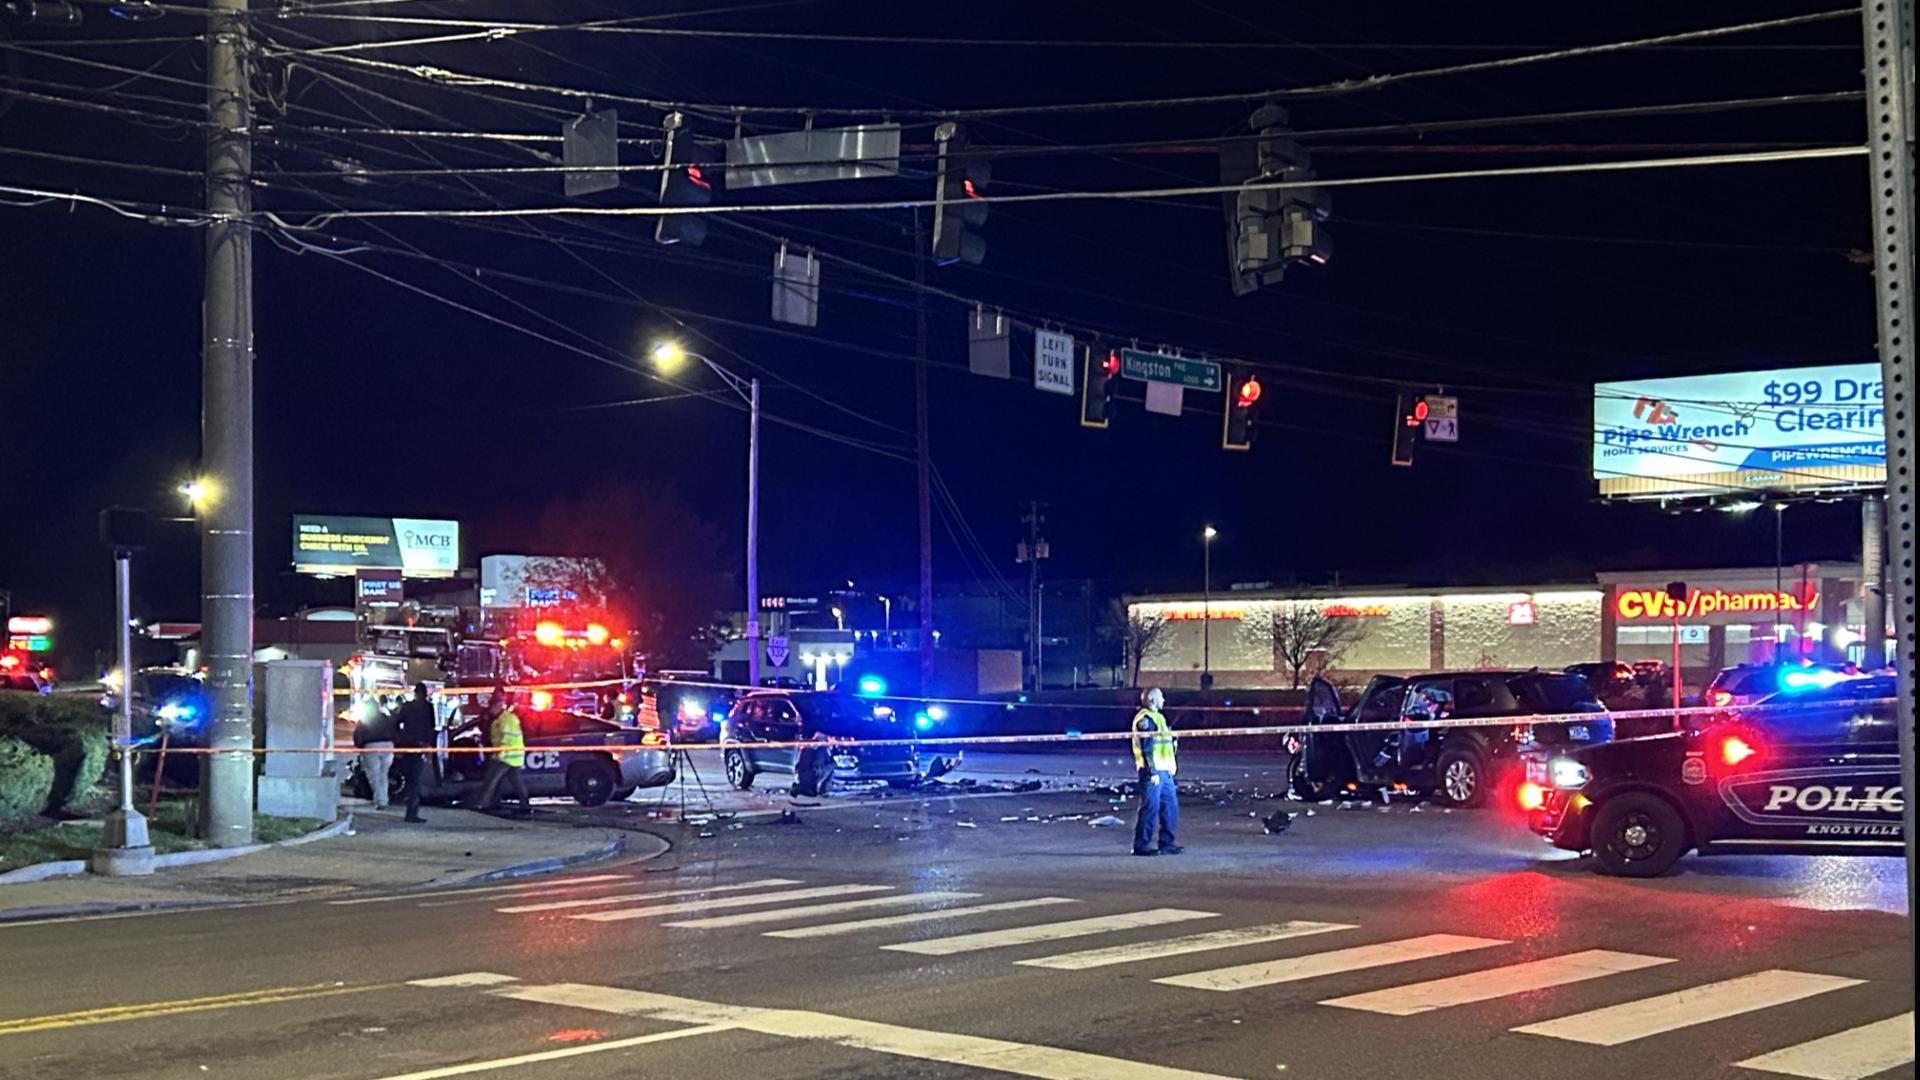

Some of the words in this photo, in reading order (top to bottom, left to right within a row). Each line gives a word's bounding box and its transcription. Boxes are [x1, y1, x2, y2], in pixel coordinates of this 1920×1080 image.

[1043, 337, 1065, 352] LEFT
[1042, 353, 1066, 369] TURN
[1126, 355, 1171, 379] Kingston
[1038, 369, 1071, 387] SIGNAL
[1763, 379, 1822, 408] $99
[1603, 425, 1653, 446] Pipe
[1657, 420, 1749, 441] Wrench
[1603, 447, 1634, 457] HOME
[1638, 444, 1689, 454] SERVICES
[415, 534, 450, 547] MCB
[363, 588, 387, 596] BANK
[364, 581, 387, 589] FIRST
[521, 751, 560, 769] CE
[1763, 785, 1904, 812] POLIC
[1806, 824, 1901, 836] KNOXVILLE
